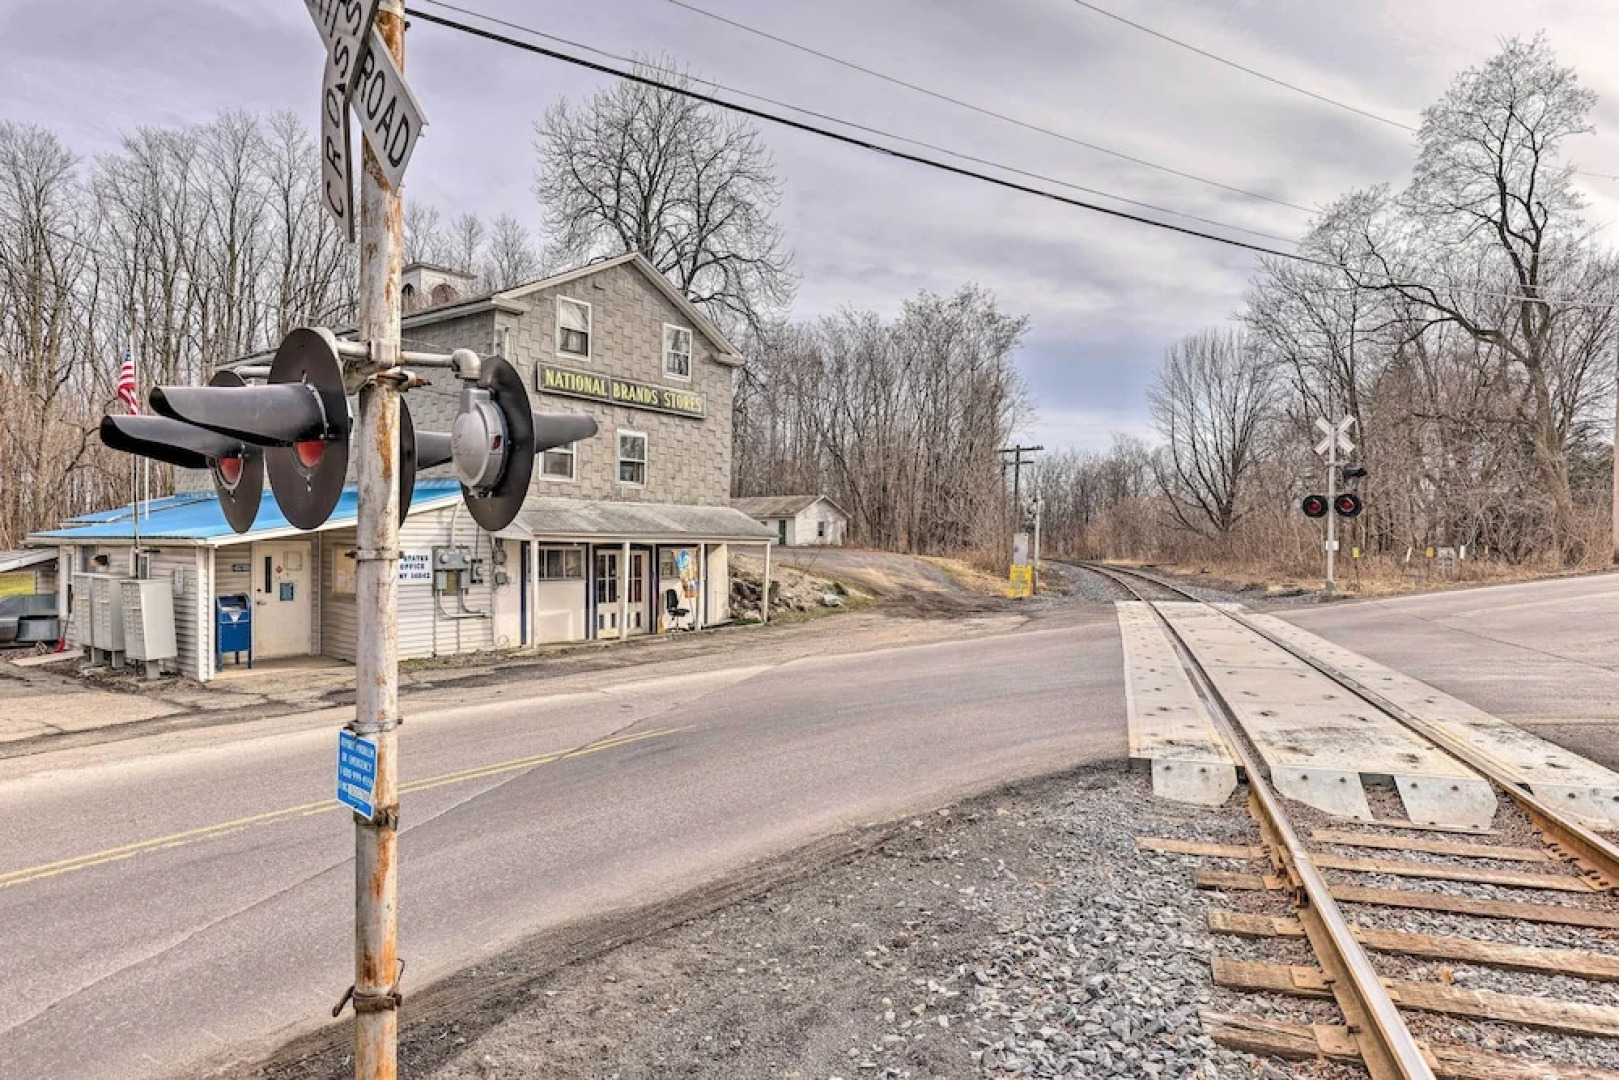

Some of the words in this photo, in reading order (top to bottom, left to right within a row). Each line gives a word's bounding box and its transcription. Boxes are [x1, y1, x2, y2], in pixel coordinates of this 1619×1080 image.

[354, 46, 411, 168] ROAD
[544, 368, 608, 396] NATIONAL
[612, 382, 658, 405] BRANDS
